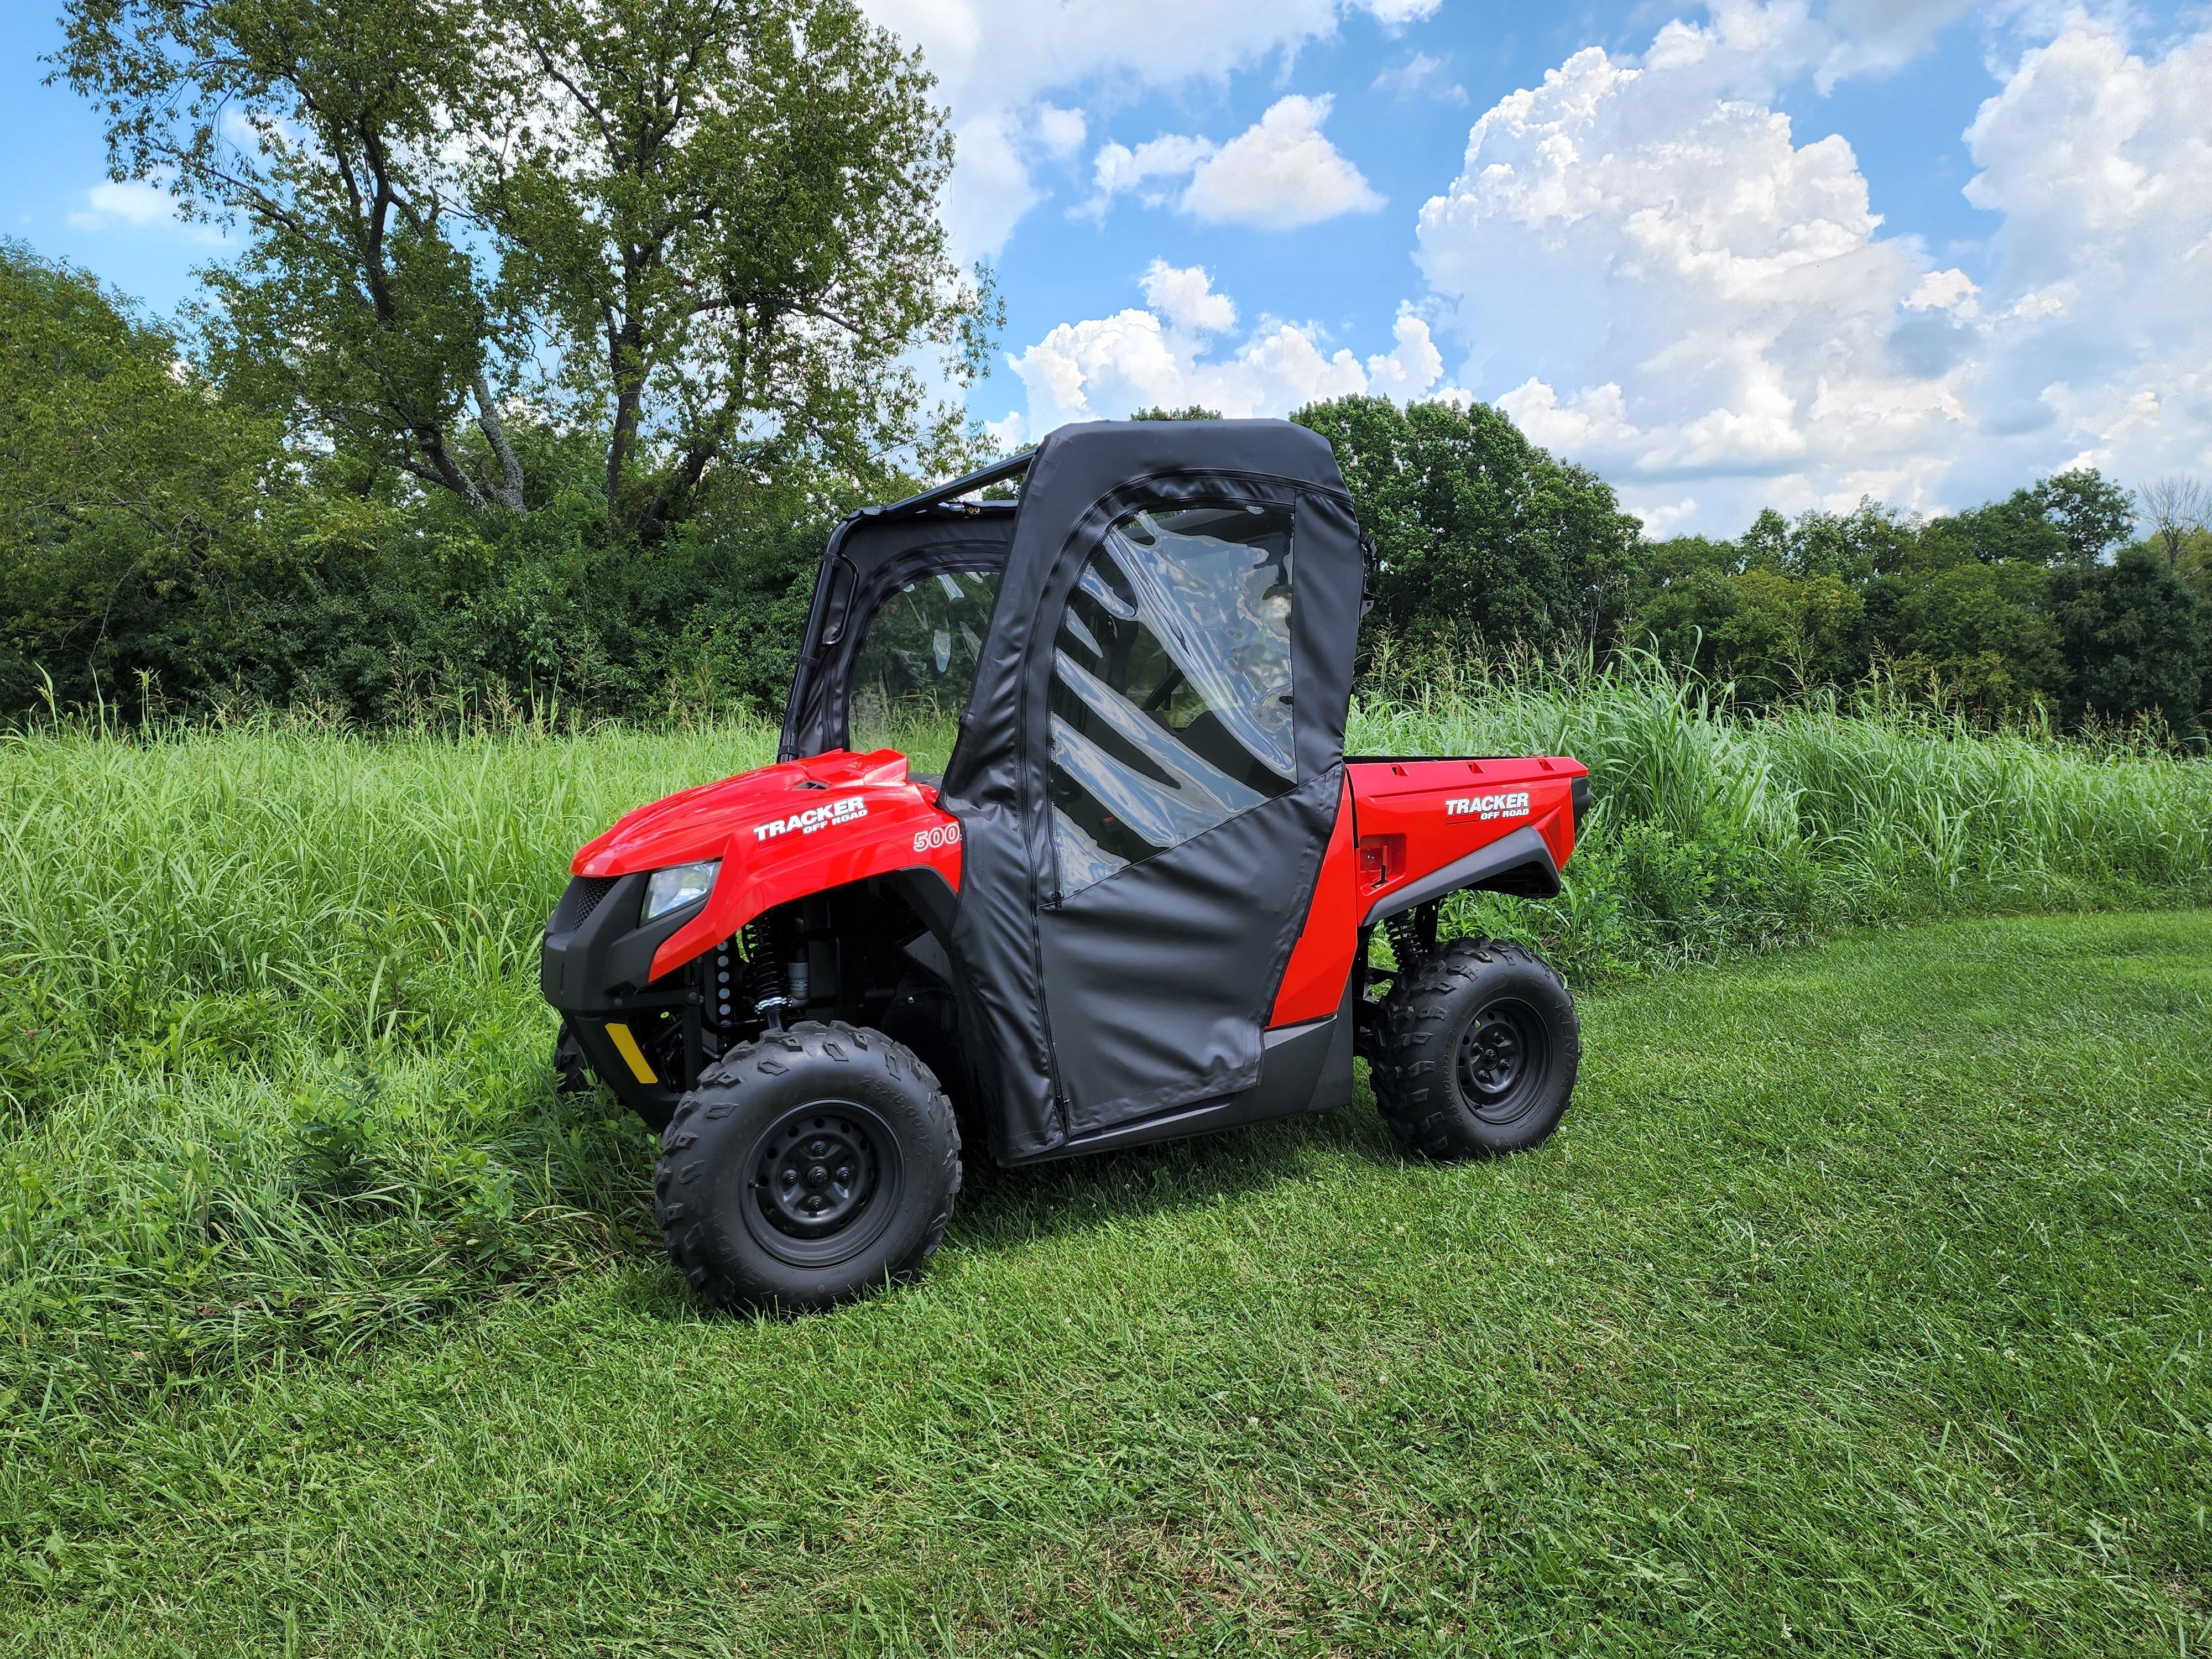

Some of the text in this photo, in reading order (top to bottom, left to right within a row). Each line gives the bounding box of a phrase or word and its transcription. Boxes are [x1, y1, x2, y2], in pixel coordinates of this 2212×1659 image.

[1446, 792, 1529, 816] TRACKER
[1480, 808, 1529, 820] OFF ROAD
[753, 796, 864, 841] TRACKER
[803, 809, 868, 834] OFF ROAD
[913, 823, 960, 852] 500
